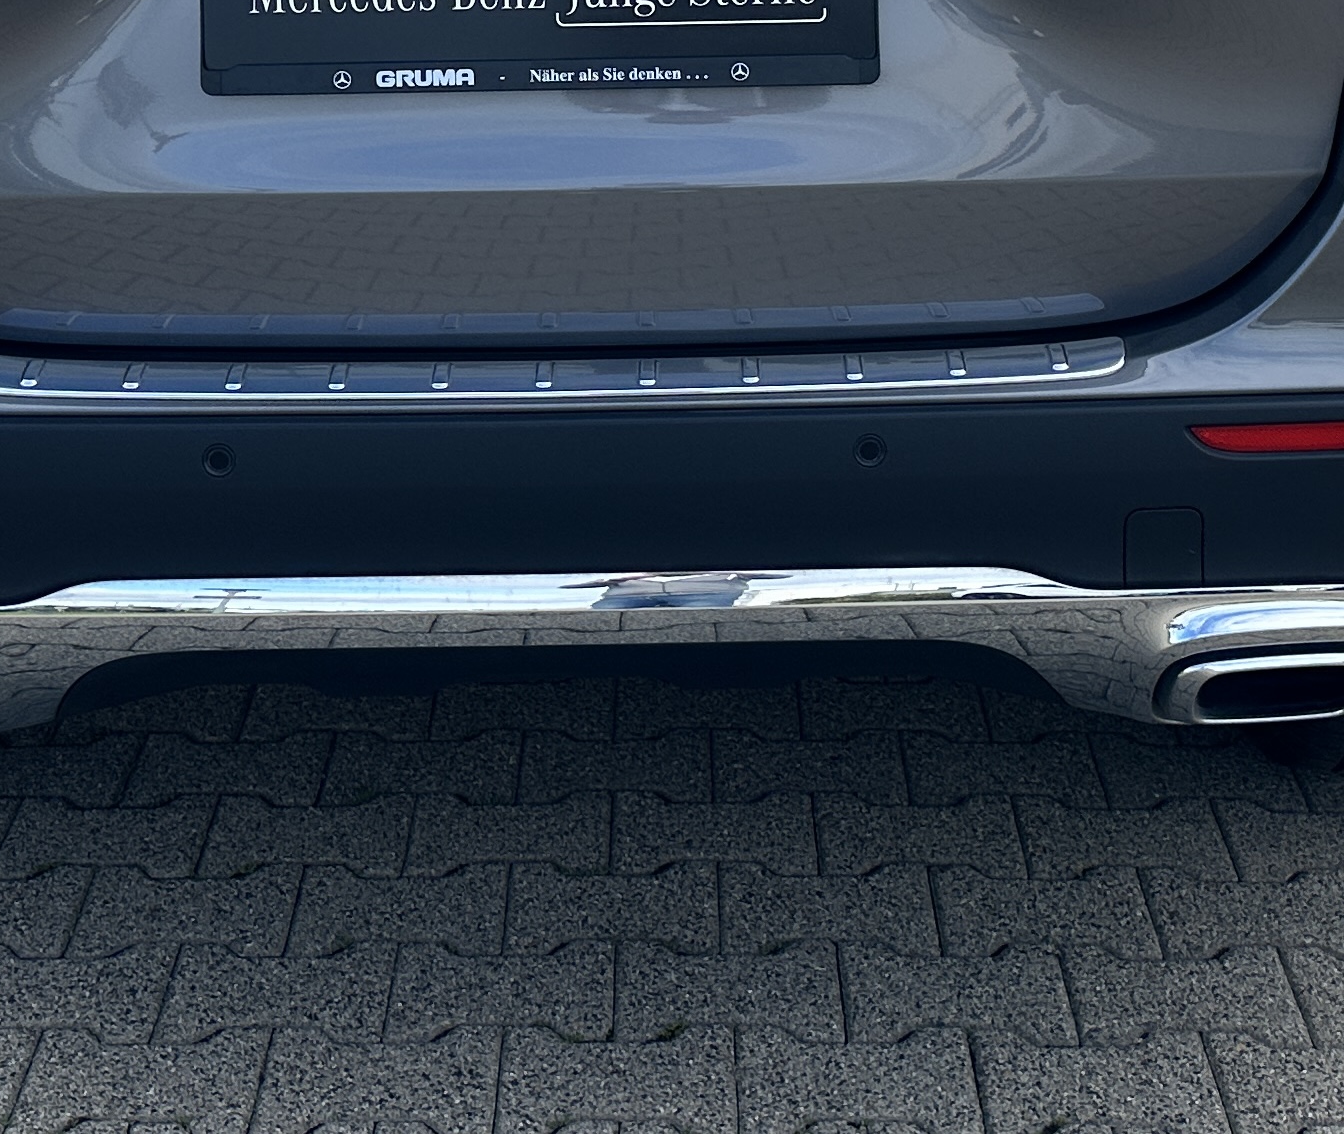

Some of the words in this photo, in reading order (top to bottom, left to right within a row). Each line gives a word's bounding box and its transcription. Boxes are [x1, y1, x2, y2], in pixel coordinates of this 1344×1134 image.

[375, 68, 475, 88] GRUMA
[529, 68, 576, 83] Näher
[578, 68, 600, 82] als
[602, 67, 626, 81] Sie
[628, 66, 682, 82] denken
